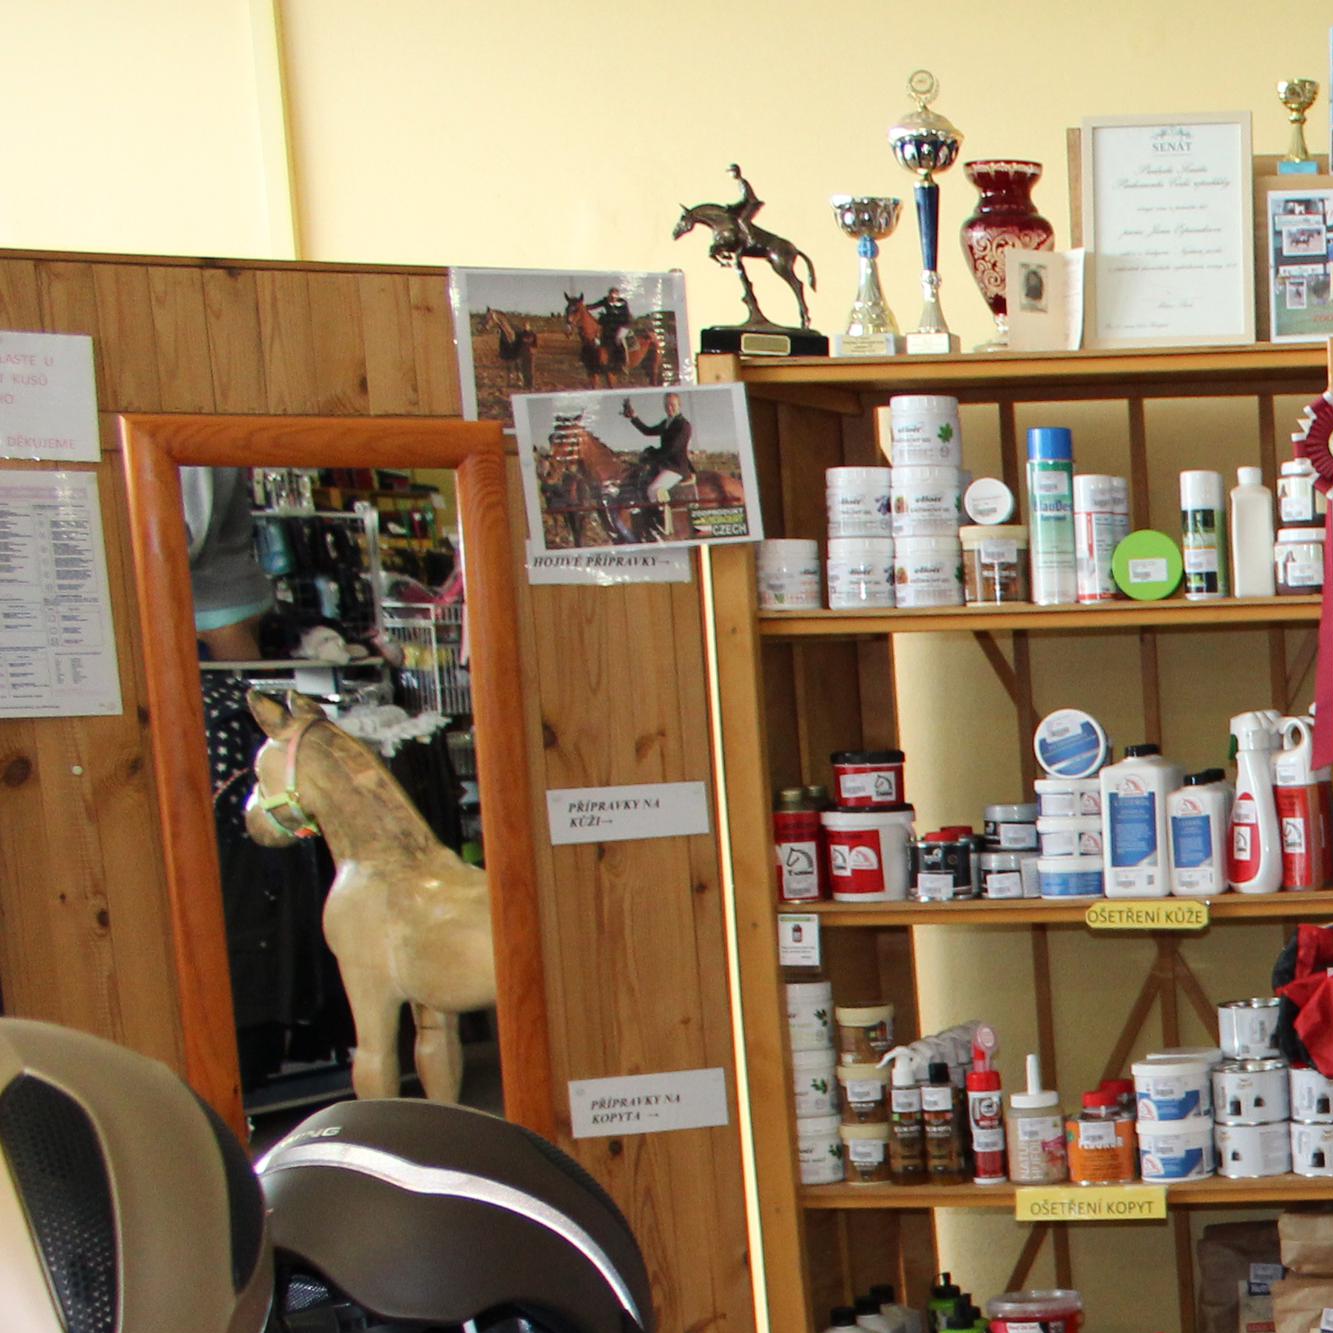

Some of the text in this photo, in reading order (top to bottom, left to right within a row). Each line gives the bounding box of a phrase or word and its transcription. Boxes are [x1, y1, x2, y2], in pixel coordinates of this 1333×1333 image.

[712, 522, 747, 537] CZECH
[533, 550, 659, 570] HOJIVÉ PŘÍPRAVKY
[568, 797, 661, 814] PŘÍPRAVKY NA
[1086, 902, 1204, 926] OŠETŘENÍ KŮŽE
[590, 1093, 682, 1111] PŘÍPRAVKY NA
[592, 1110, 642, 1126] KOPYTA
[1030, 1198, 1155, 1217] OŠETŘENÍ KOPYT
